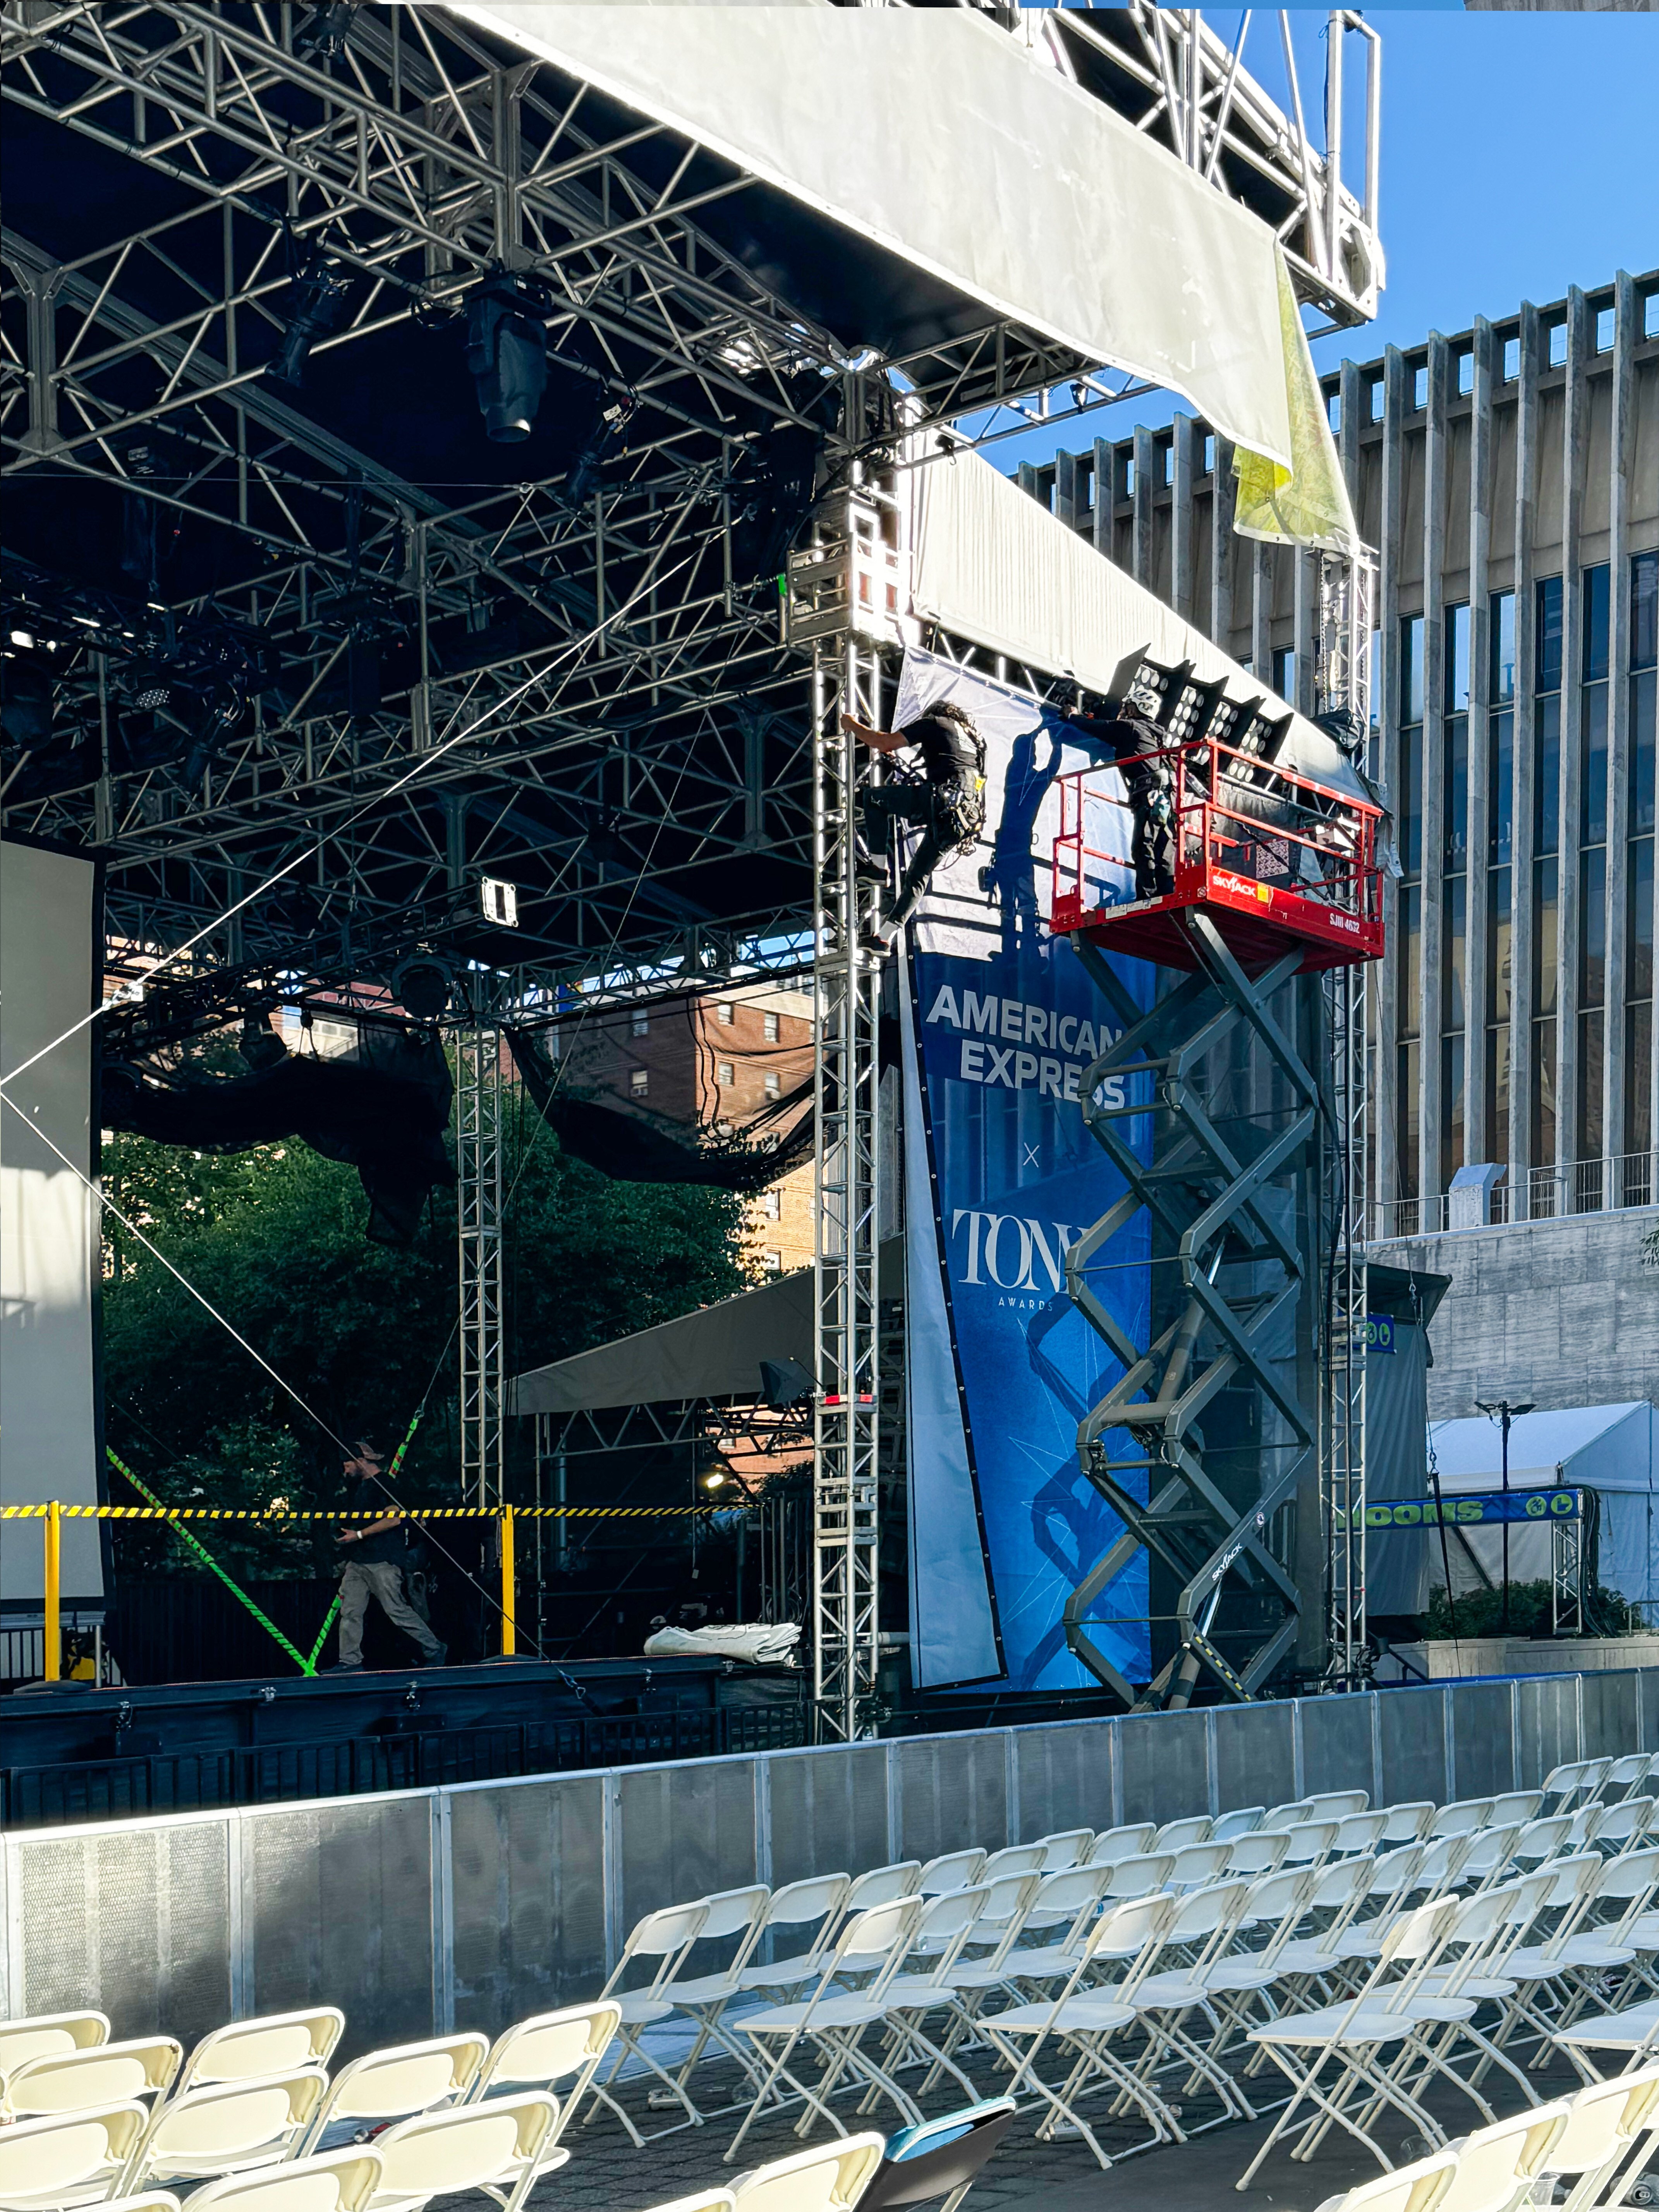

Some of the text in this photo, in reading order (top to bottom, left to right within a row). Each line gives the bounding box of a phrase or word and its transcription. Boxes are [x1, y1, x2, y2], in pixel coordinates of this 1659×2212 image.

[1213, 875, 1256, 897] SKYJACK
[926, 984, 1122, 1060] AMERICAN
[998, 1297, 1053, 1311] AWARDS
[1212, 1542, 1243, 1581] SKYJACK
